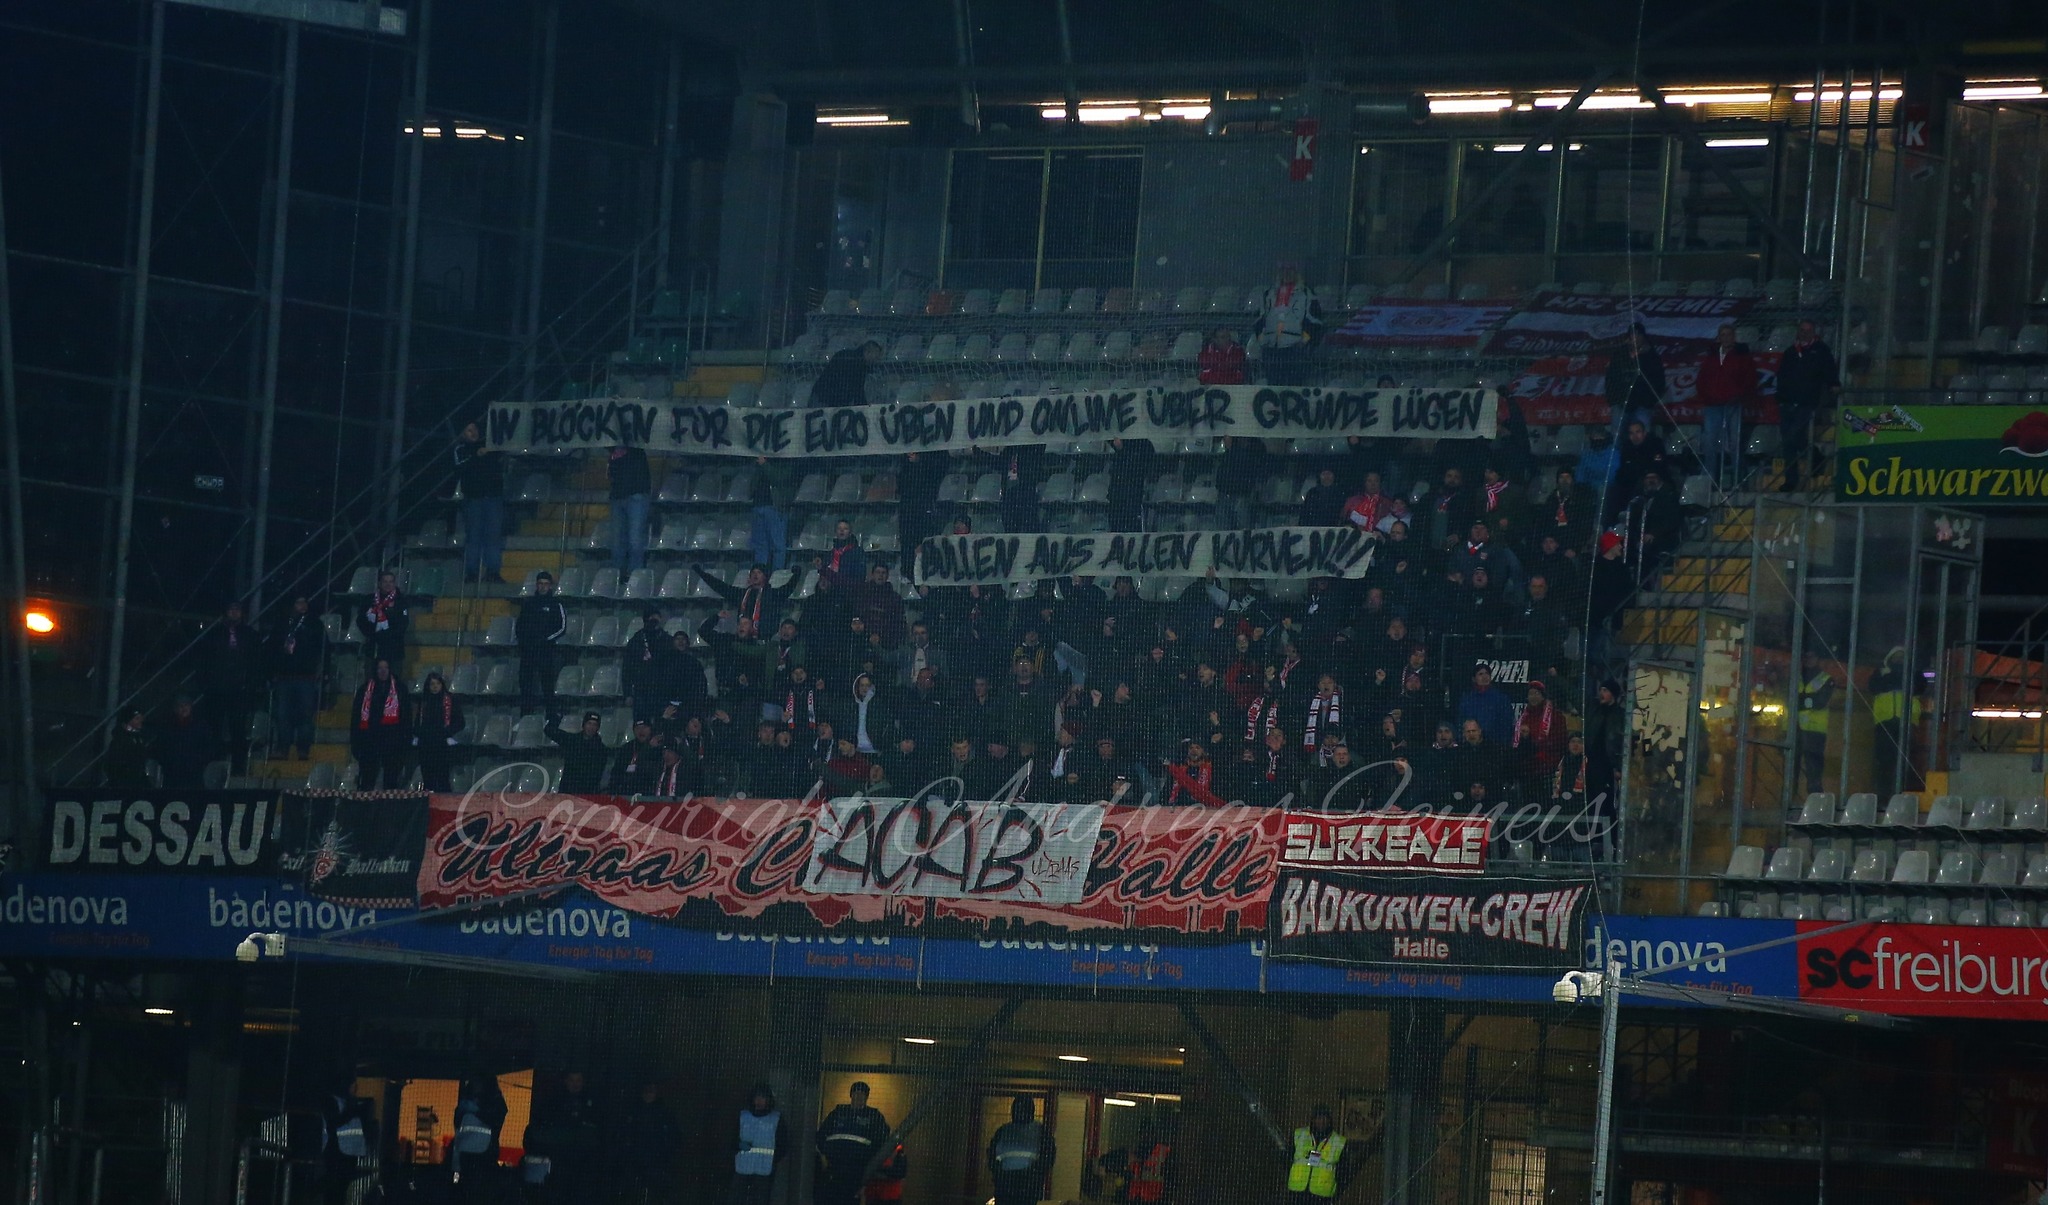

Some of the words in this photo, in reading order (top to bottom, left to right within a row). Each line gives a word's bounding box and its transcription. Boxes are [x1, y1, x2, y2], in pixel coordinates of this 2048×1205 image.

[1296, 135, 1313, 159] K
[1906, 121, 1926, 146] K
[1615, 298, 1738, 314] CHEMIE
[490, 407, 521, 446] IN
[530, 400, 657, 446] BLÖCKEN
[742, 410, 794, 452] DIE
[804, 408, 869, 453] EURO
[878, 402, 956, 447] ÜBEN
[966, 399, 1024, 440] UND
[1146, 387, 1236, 429] ÜBER
[1252, 388, 1379, 431] GRÜNDE
[1391, 387, 1486, 432] LÜGEN
[1024, 535, 1095, 575] AUS
[1098, 533, 1202, 574] ALLEN
[50, 800, 268, 866] DESSAU
[815, 799, 1043, 892] ACAB
[1284, 823, 1484, 865] SURREALE
[0, 883, 129, 926] denova
[1281, 877, 1585, 951] BADKURVEN-CREW
[1393, 936, 1450, 958] Halle
[1585, 925, 1728, 974] denova
[2012, 1107, 2038, 1157] K
